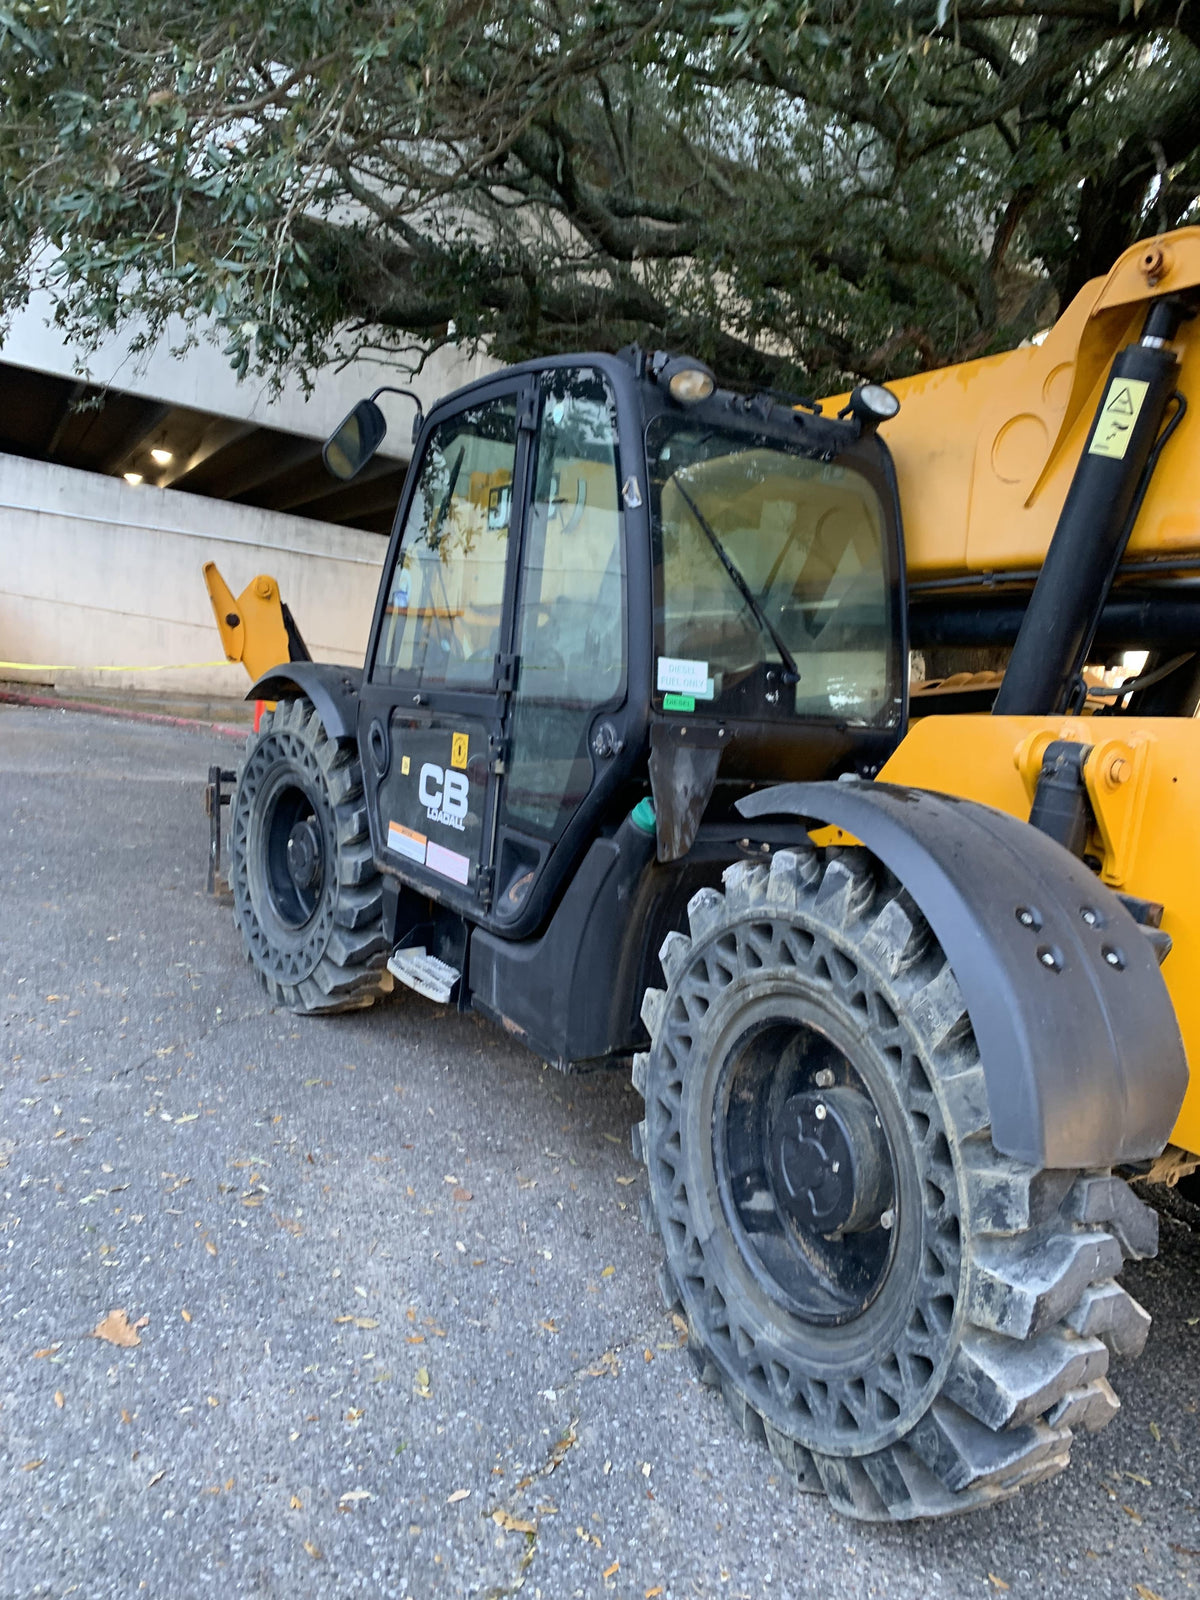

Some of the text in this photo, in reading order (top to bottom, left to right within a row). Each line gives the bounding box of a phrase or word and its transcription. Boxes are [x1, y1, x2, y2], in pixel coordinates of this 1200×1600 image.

[668, 664, 696, 674] DIESEL
[661, 675, 681, 687] FUEL
[427, 807, 466, 832] LOADALL
